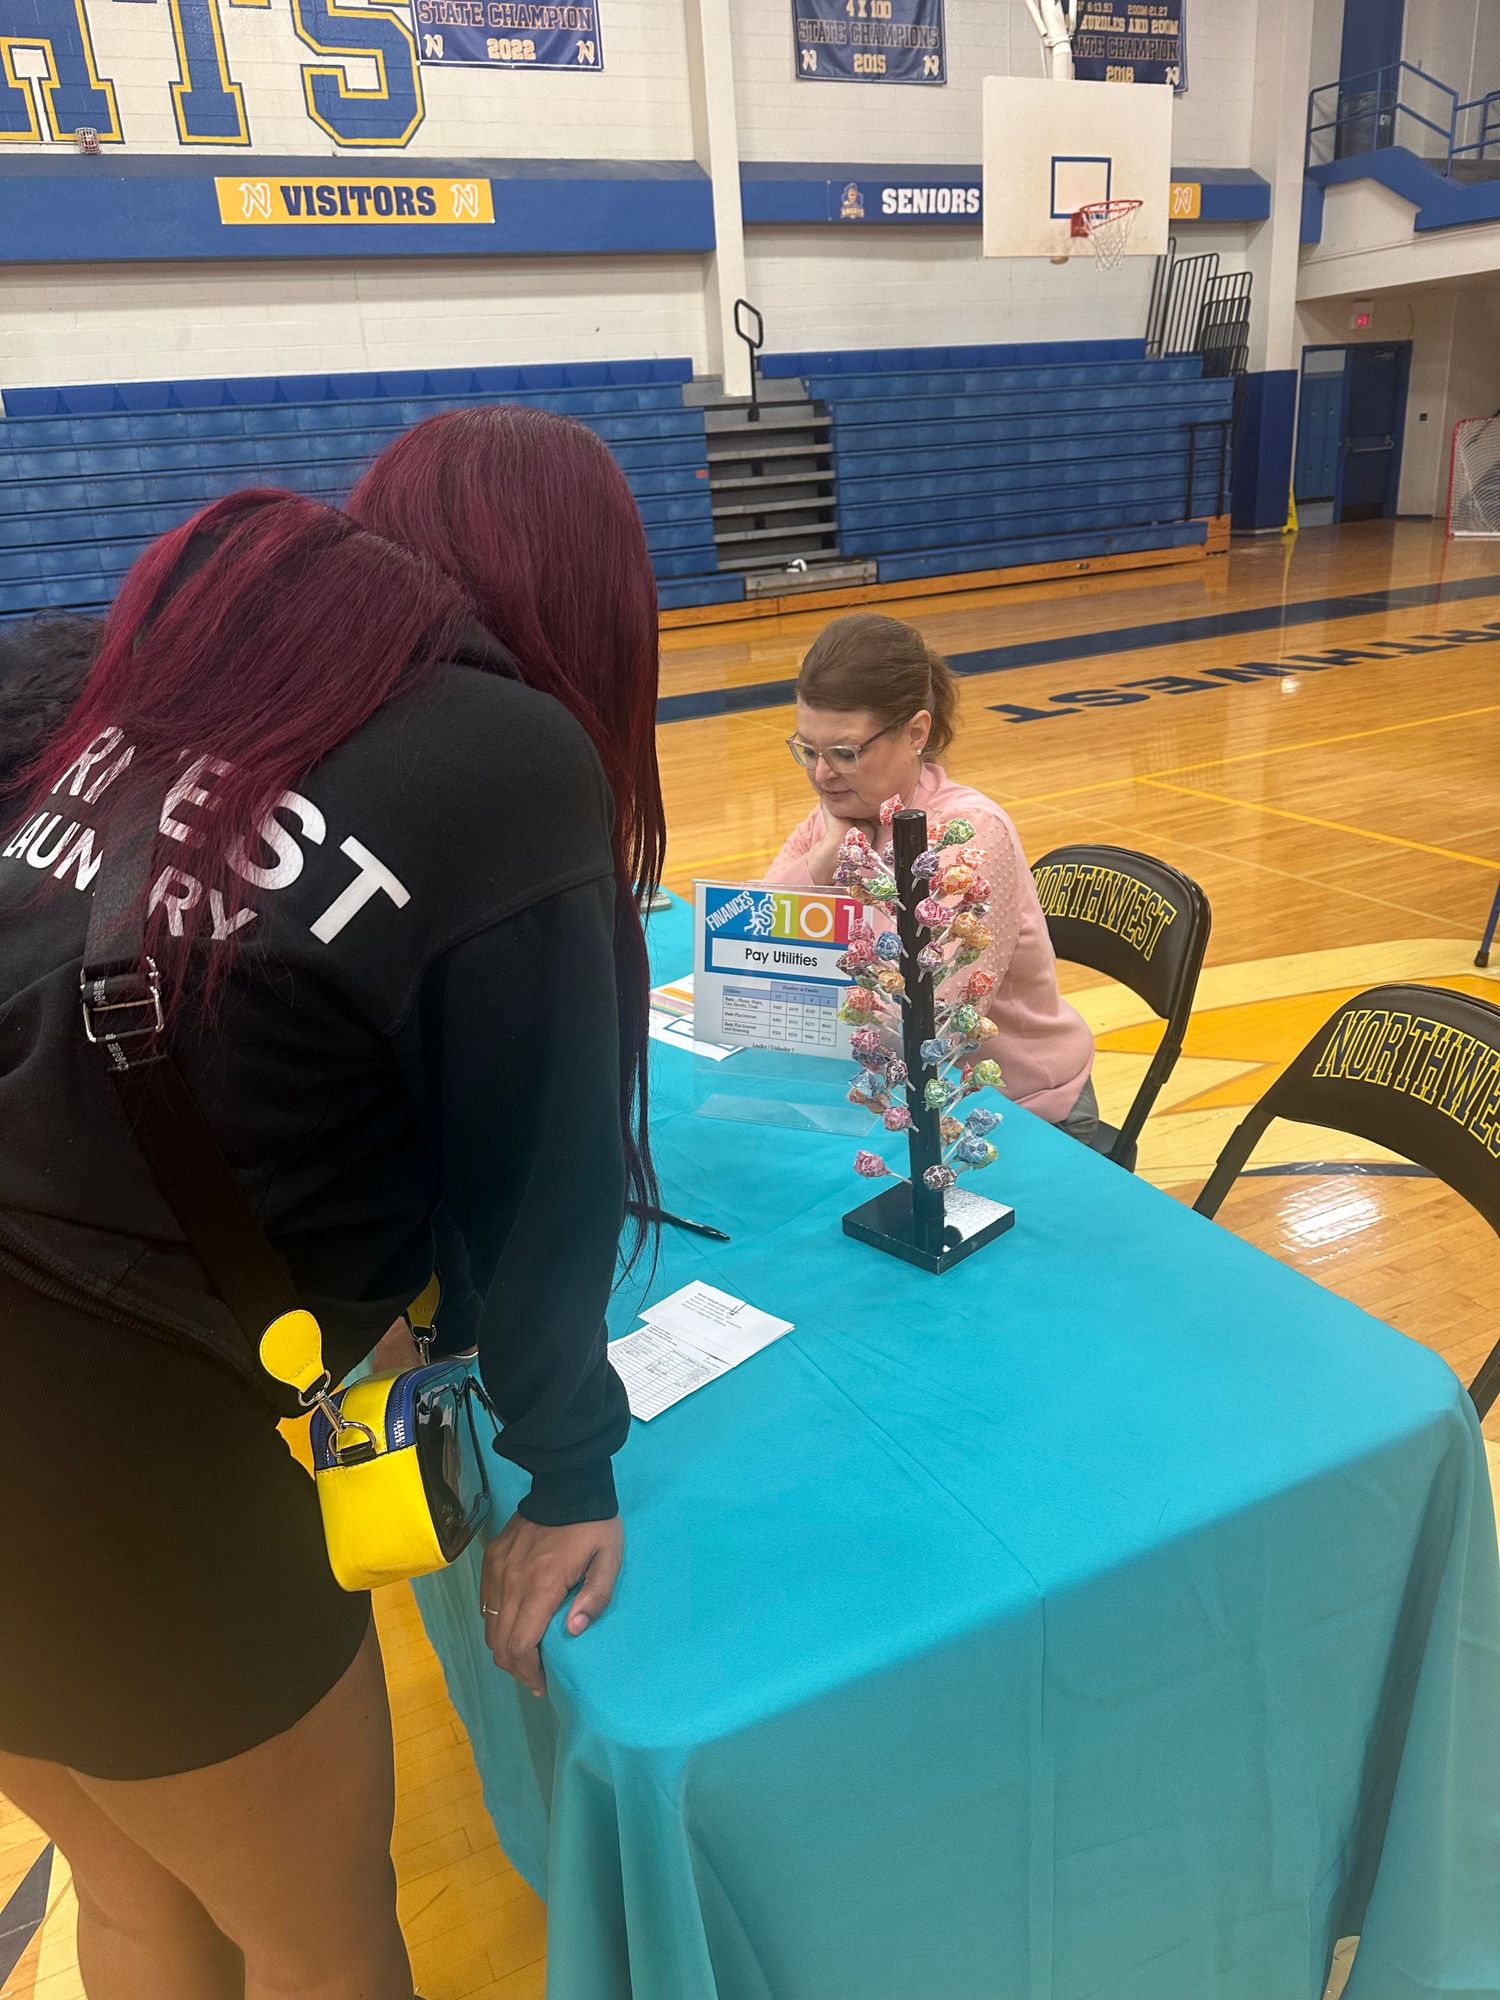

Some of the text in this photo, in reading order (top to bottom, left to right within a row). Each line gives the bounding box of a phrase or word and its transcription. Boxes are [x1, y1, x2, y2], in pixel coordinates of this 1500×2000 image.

[418, 0, 593, 31] STATE CHAMPION
[797, 18, 940, 48] STATE CHAMPIONS
[487, 38, 536, 60] 2022
[1107, 37, 1181, 61] CHAMPION
[853, 53, 887, 74] 2015
[280, 185, 437, 216] VISITORS
[882, 188, 980, 215] SENIORS
[706, 890, 855, 941] FINANCES 101
[745, 948, 818, 967] Pay Utilities
